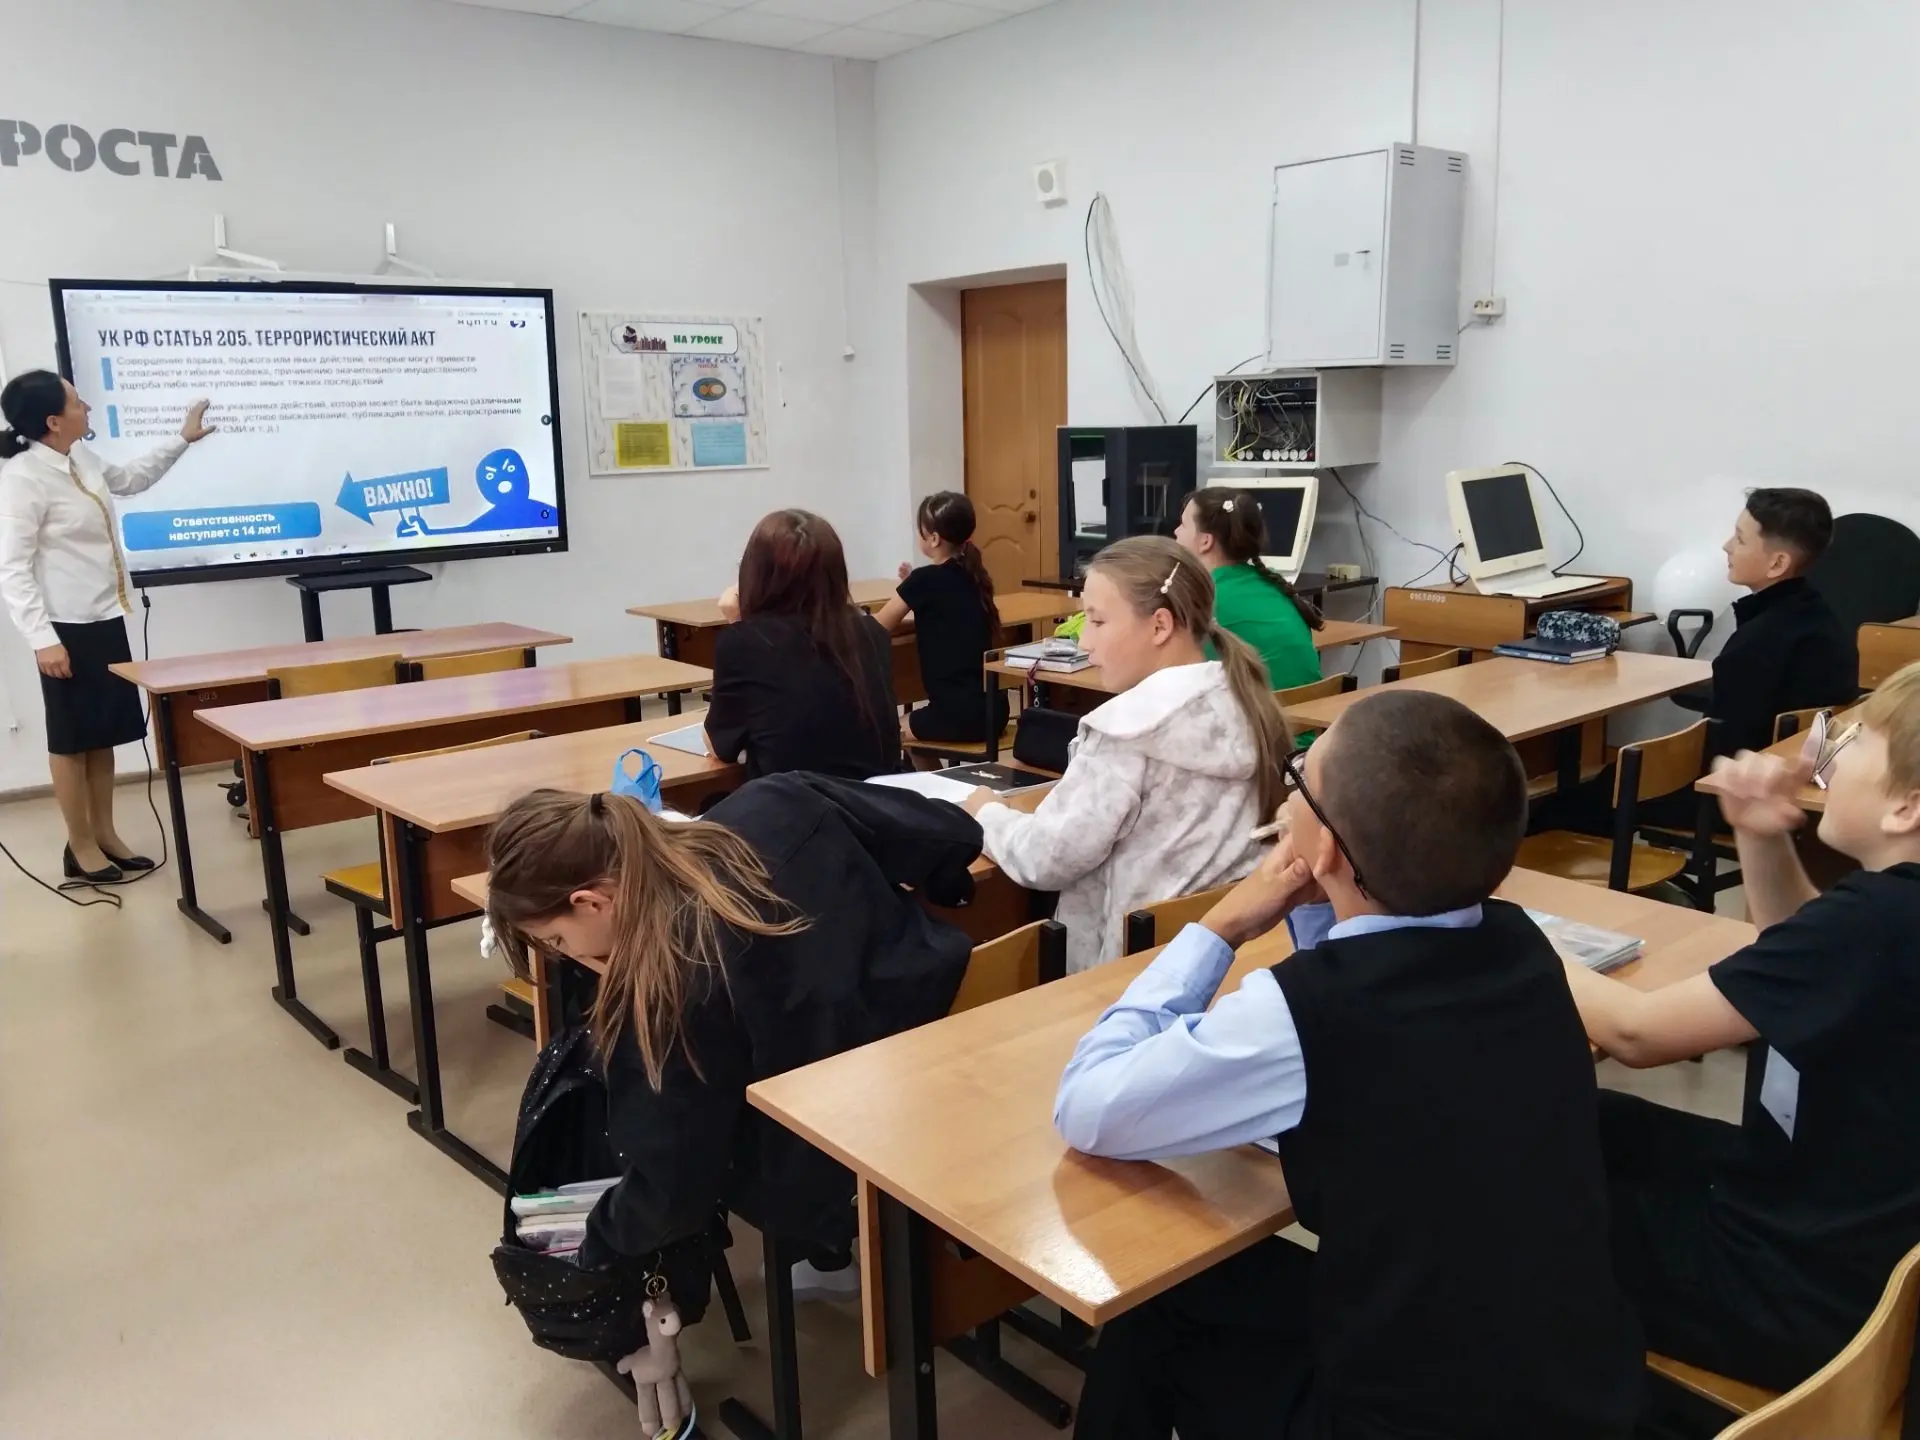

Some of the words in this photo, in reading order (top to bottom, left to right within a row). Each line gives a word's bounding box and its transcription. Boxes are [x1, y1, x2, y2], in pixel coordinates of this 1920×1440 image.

[0, 119, 222, 181] РОСТА
[98, 329, 120, 348] УК
[125, 329, 149, 347] РФ
[154, 329, 213, 347] СТАТЬЯ
[217, 329, 252, 347] 205.
[257, 327, 407, 347] ТЕРРОРИСТИЧЕСКИЙ
[411, 330, 436, 347] АКТ
[673, 334, 688, 344] НА
[691, 335, 723, 345] УРОКЕ
[363, 477, 434, 508] ВАЖНО!
[172, 513, 276, 528] Ответственность
[169, 528, 231, 542] наступает
[242, 527, 256, 536] 14
[258, 525, 281, 535] лет!
